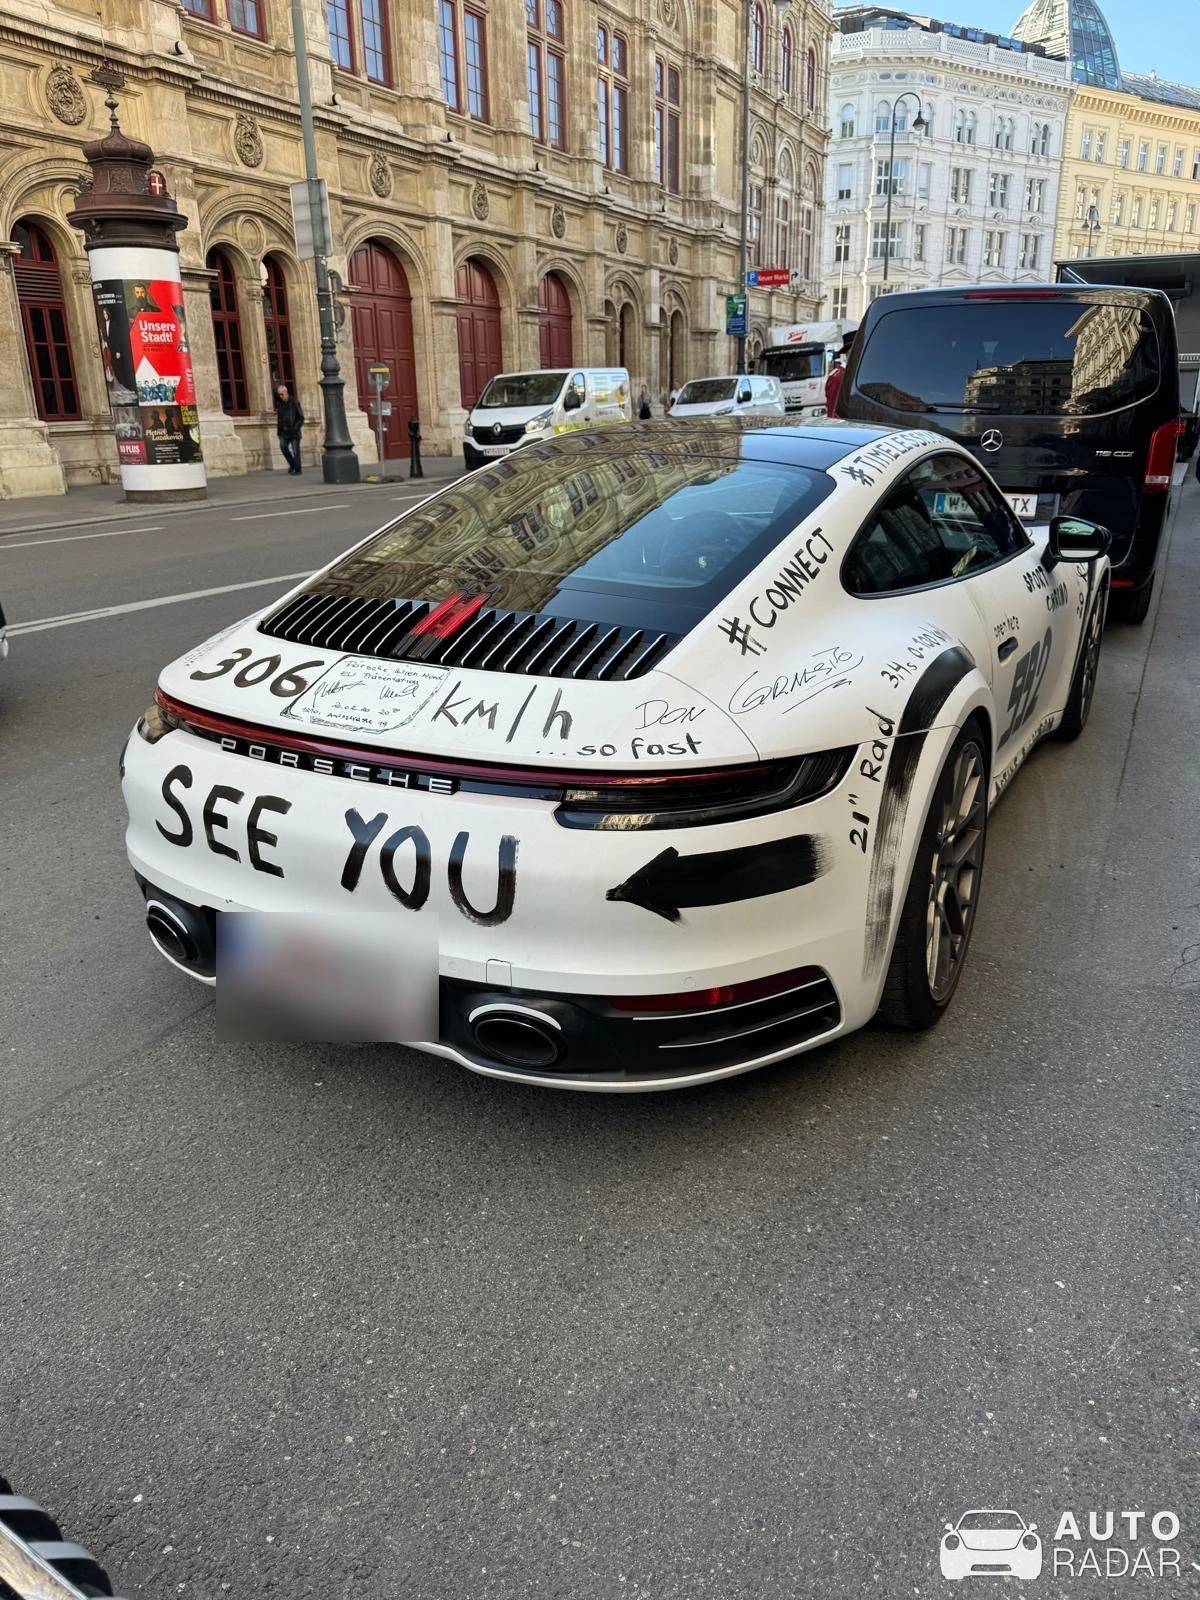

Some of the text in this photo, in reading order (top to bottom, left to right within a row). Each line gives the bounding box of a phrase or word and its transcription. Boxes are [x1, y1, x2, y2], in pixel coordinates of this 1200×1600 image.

[139, 320, 176, 332] Unsere
[141, 331, 173, 343] Stadt!
[126, 445, 140, 454] PLUS
[1012, 498, 1030, 512] TX
[718, 527, 835, 656] #CONNECT
[1023, 565, 1049, 593] SPORT
[190, 647, 326, 698] 306
[632, 734, 703, 760] fast
[861, 707, 896, 782] Rad
[220, 737, 455, 795] PORSCHE
[155, 764, 521, 928] SEE YOU
